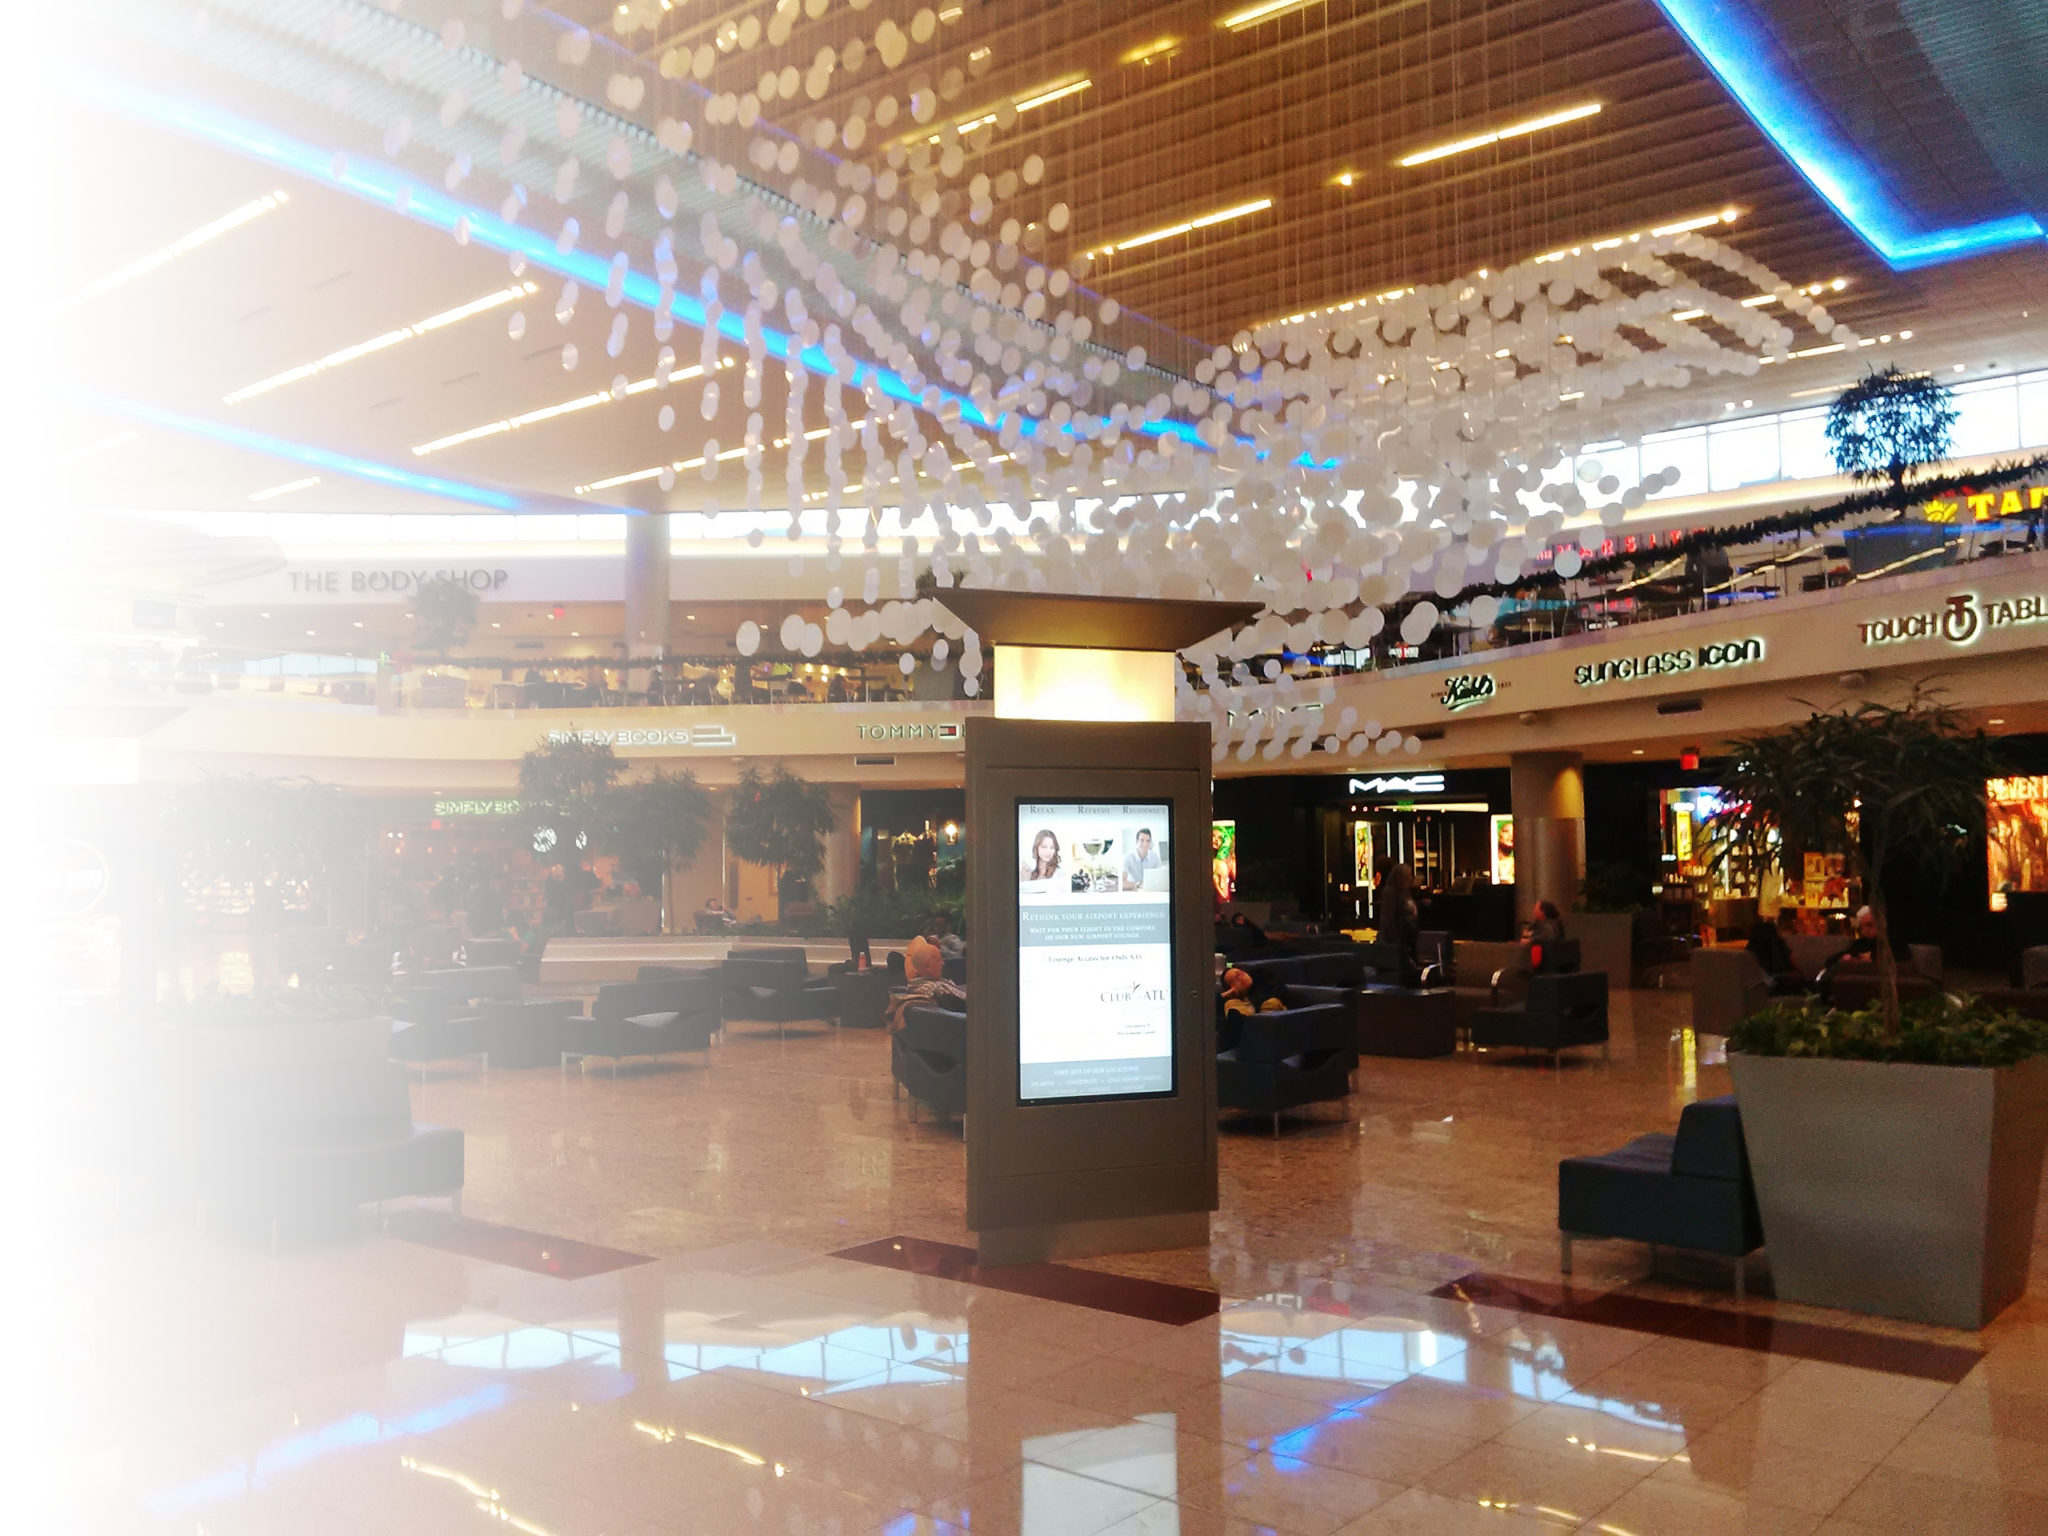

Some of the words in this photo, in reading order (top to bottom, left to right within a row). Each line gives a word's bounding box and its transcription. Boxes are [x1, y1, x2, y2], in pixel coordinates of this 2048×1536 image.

[288, 571, 340, 592] THE
[351, 570, 427, 591] BODY
[1858, 613, 1938, 644] TOUCH
[1574, 650, 1692, 685] SUNGLASS
[1698, 638, 1764, 668] ICON
[549, 729, 615, 746] SIMPLY
[617, 729, 689, 746] BOOKS
[856, 724, 937, 739] TOMMY
[434, 800, 491, 816] SIMPLY
[1030, 805, 1055, 815] RELAX
[1078, 805, 1110, 815] REFRESH
[1022, 911, 1059, 921] RETHINK
[1061, 912, 1083, 920] YOUR
[1085, 911, 1117, 919] AIRPORT
[1119, 910, 1165, 919] EXPERIENCE
[1100, 992, 1132, 1002] CLUB
[1143, 989, 1166, 1001] ATL
